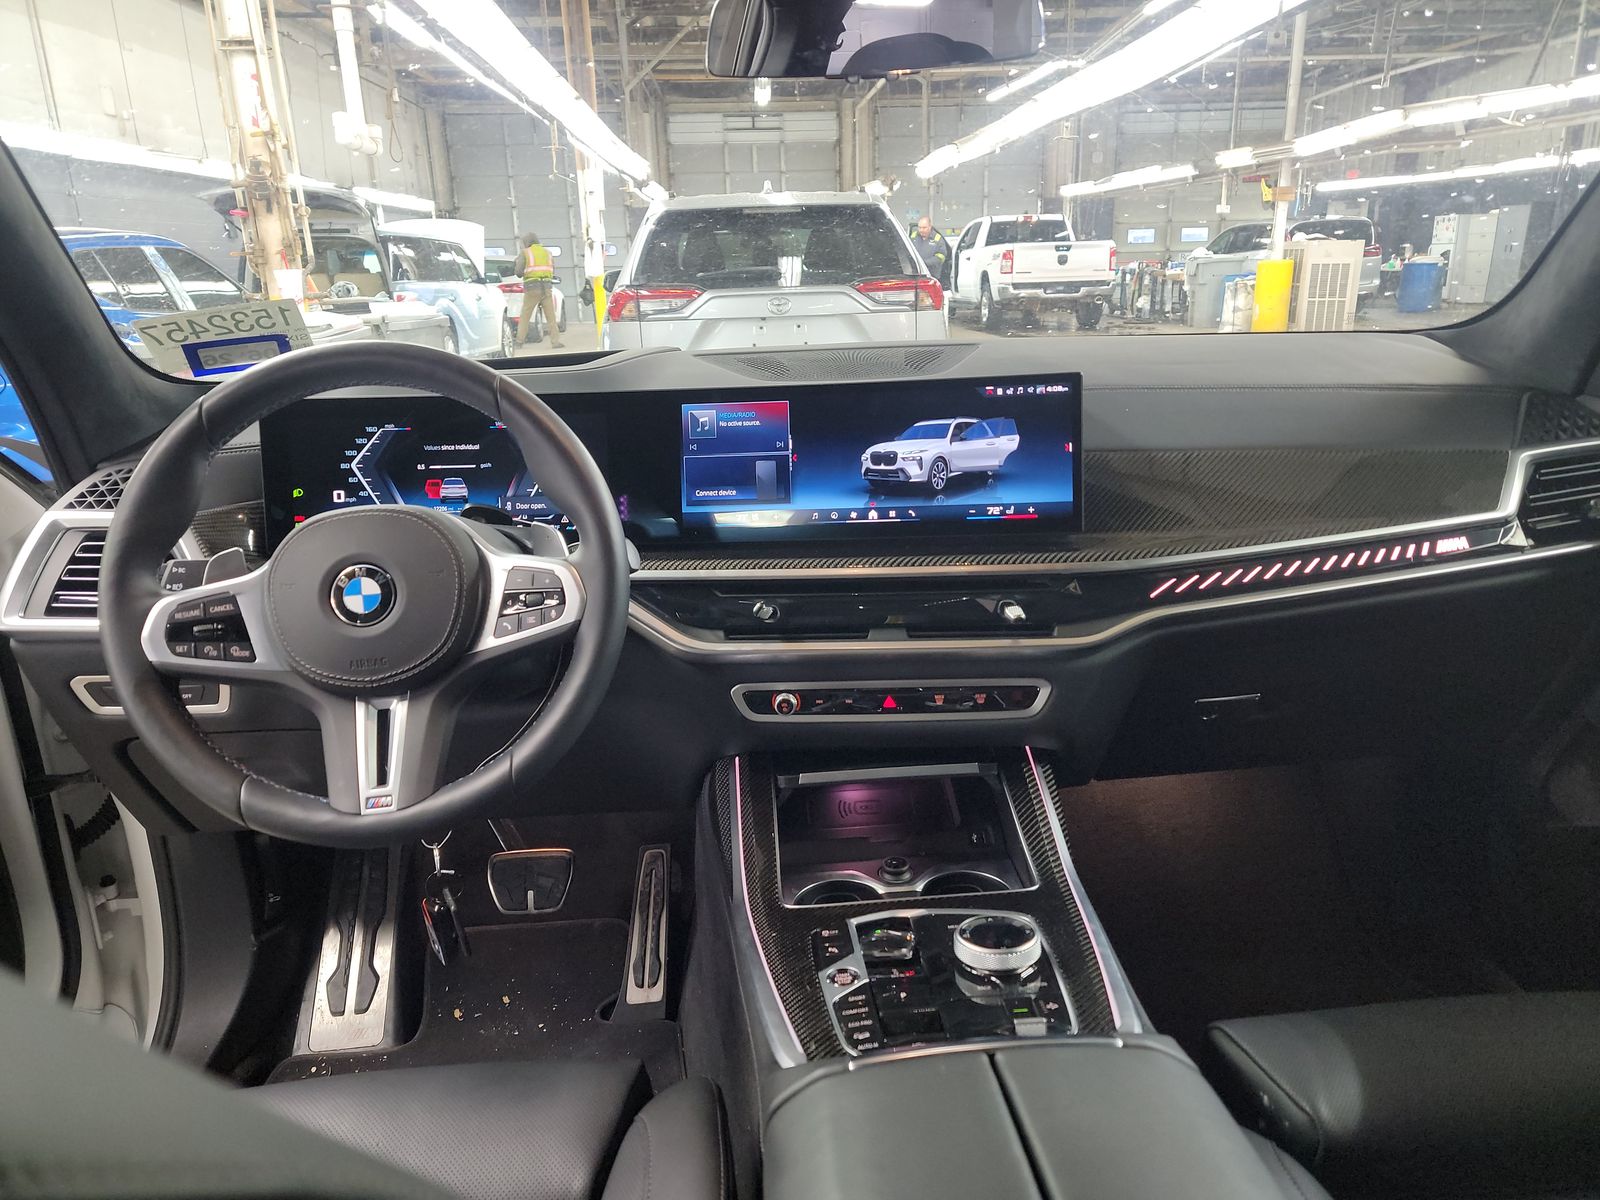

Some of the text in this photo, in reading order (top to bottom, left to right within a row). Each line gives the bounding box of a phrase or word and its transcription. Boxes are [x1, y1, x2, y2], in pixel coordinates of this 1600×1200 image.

[719, 411, 756, 419] MEDIA/RADIO
[695, 489, 718, 497] Connect
[516, 502, 547, 511] Door open.
[337, 567, 391, 588] BMW
[209, 603, 235, 613] CANCEL
[174, 608, 201, 619] RESUME
[176, 645, 188, 653] SET
